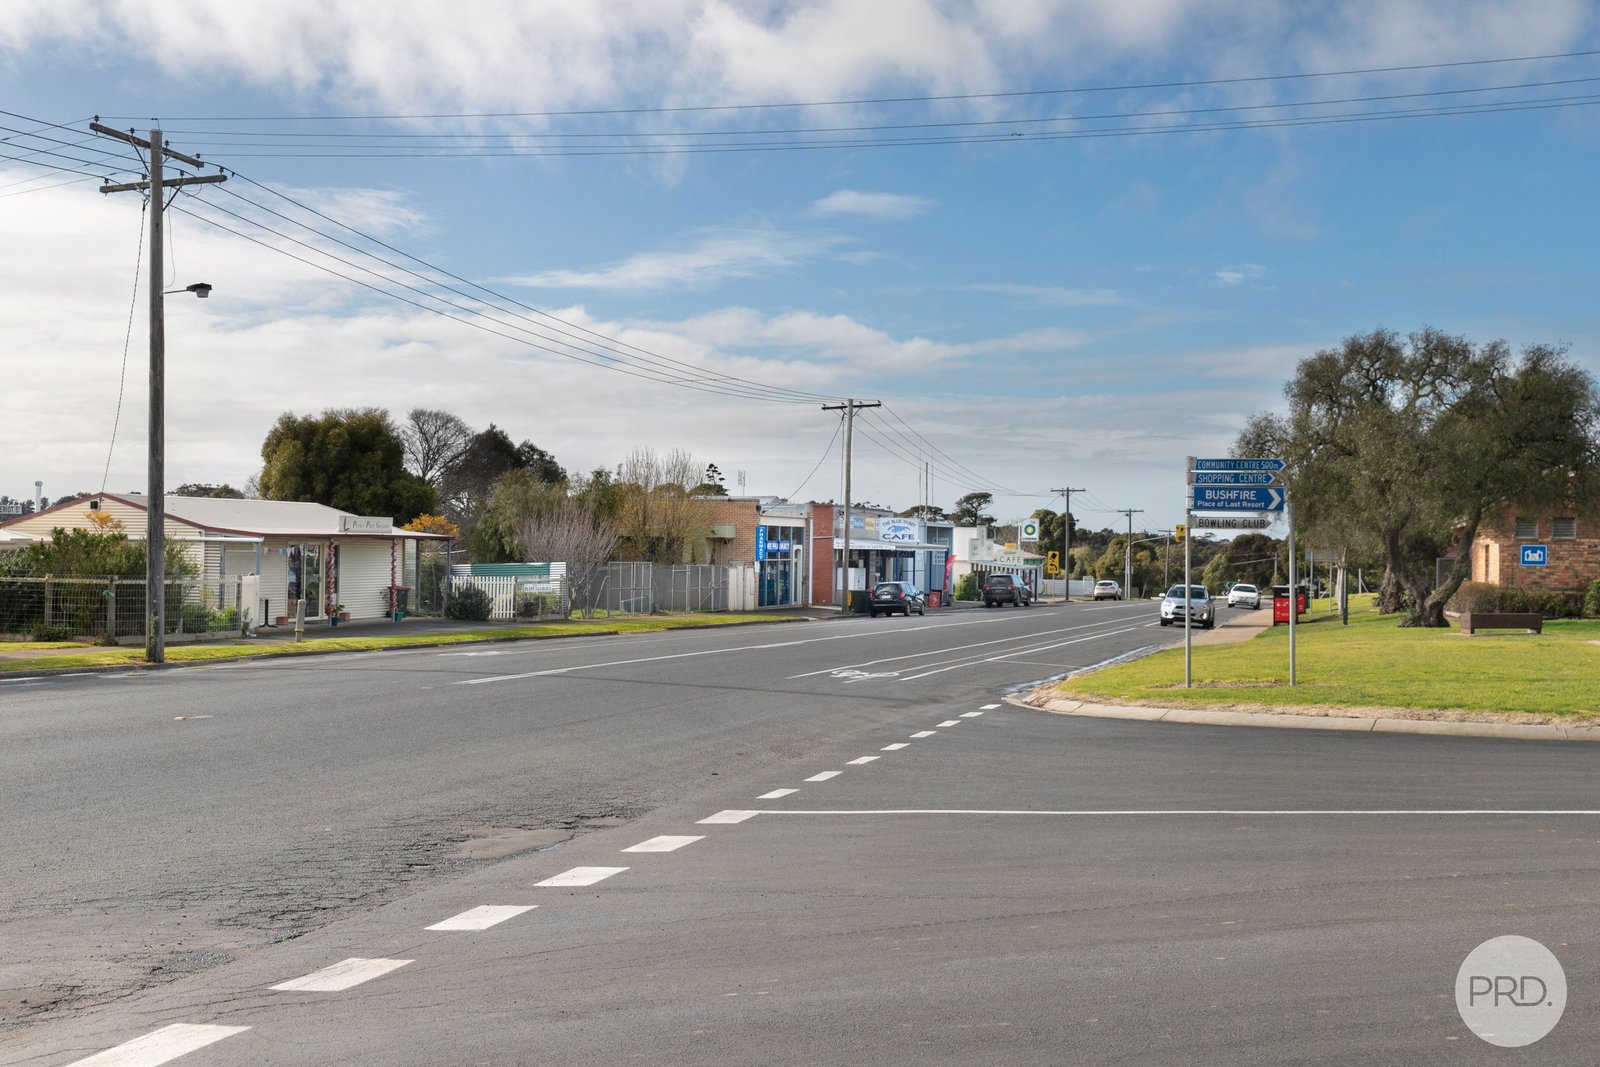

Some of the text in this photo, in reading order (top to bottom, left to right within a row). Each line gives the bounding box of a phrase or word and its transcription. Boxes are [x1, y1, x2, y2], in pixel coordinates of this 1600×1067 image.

[1197, 460, 1235, 469] COMMUNITY
[1236, 461, 1261, 470] CENTRE
[1198, 473, 1267, 483] SHOPPING CENTRE
[1205, 490, 1257, 500] BUSHFIRE
[1197, 500, 1216, 508] Place
[1216, 500, 1224, 508] of
[1225, 500, 1242, 508] Last
[882, 519, 891, 528] THE
[1198, 519, 1266, 528] BOWLING CLUB
[882, 533, 916, 541] CAFE
